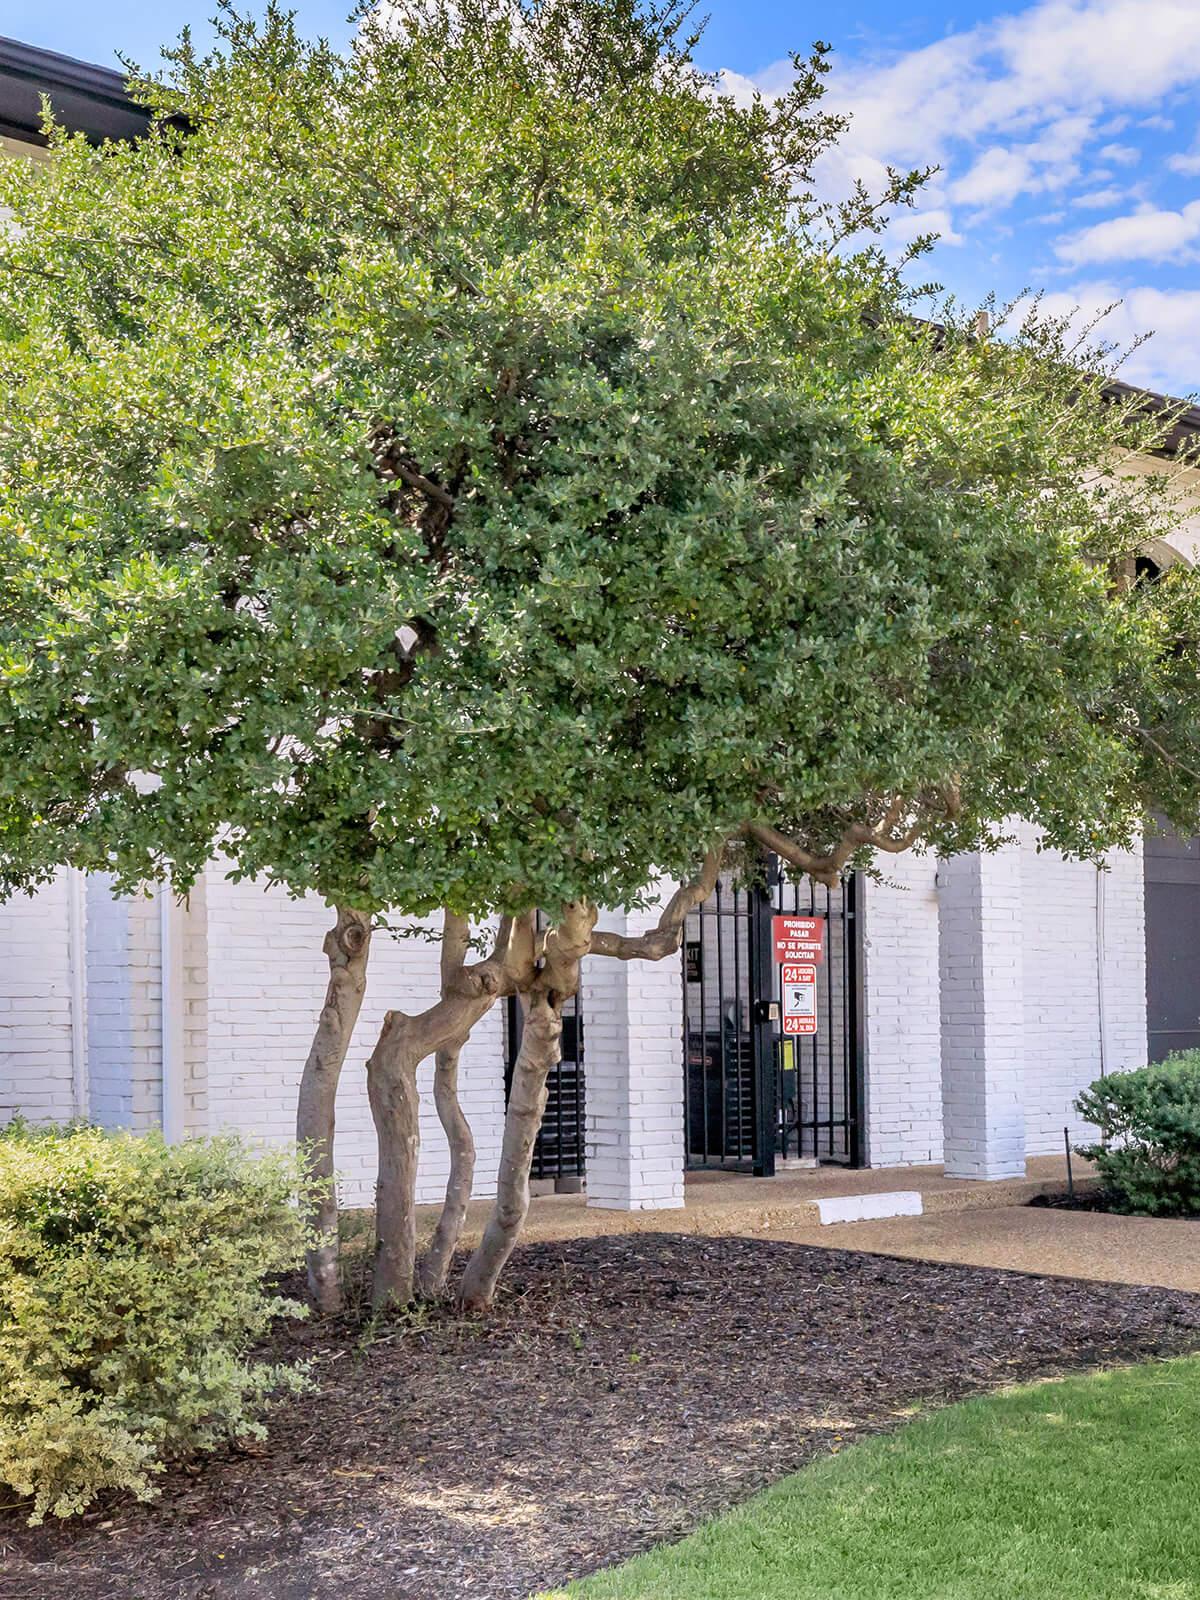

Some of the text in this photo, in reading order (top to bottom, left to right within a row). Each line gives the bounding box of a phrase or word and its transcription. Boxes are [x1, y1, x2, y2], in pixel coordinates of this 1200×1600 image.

[783, 920, 816, 929] PROHIBIDO
[790, 930, 809, 938] PASAR
[776, 941, 822, 950] NO SE PERMITE
[687, 948, 699, 961] XIT
[785, 951, 815, 959] SOLICITAR
[785, 968, 798, 981] 24
[786, 1018, 798, 1031] 24
